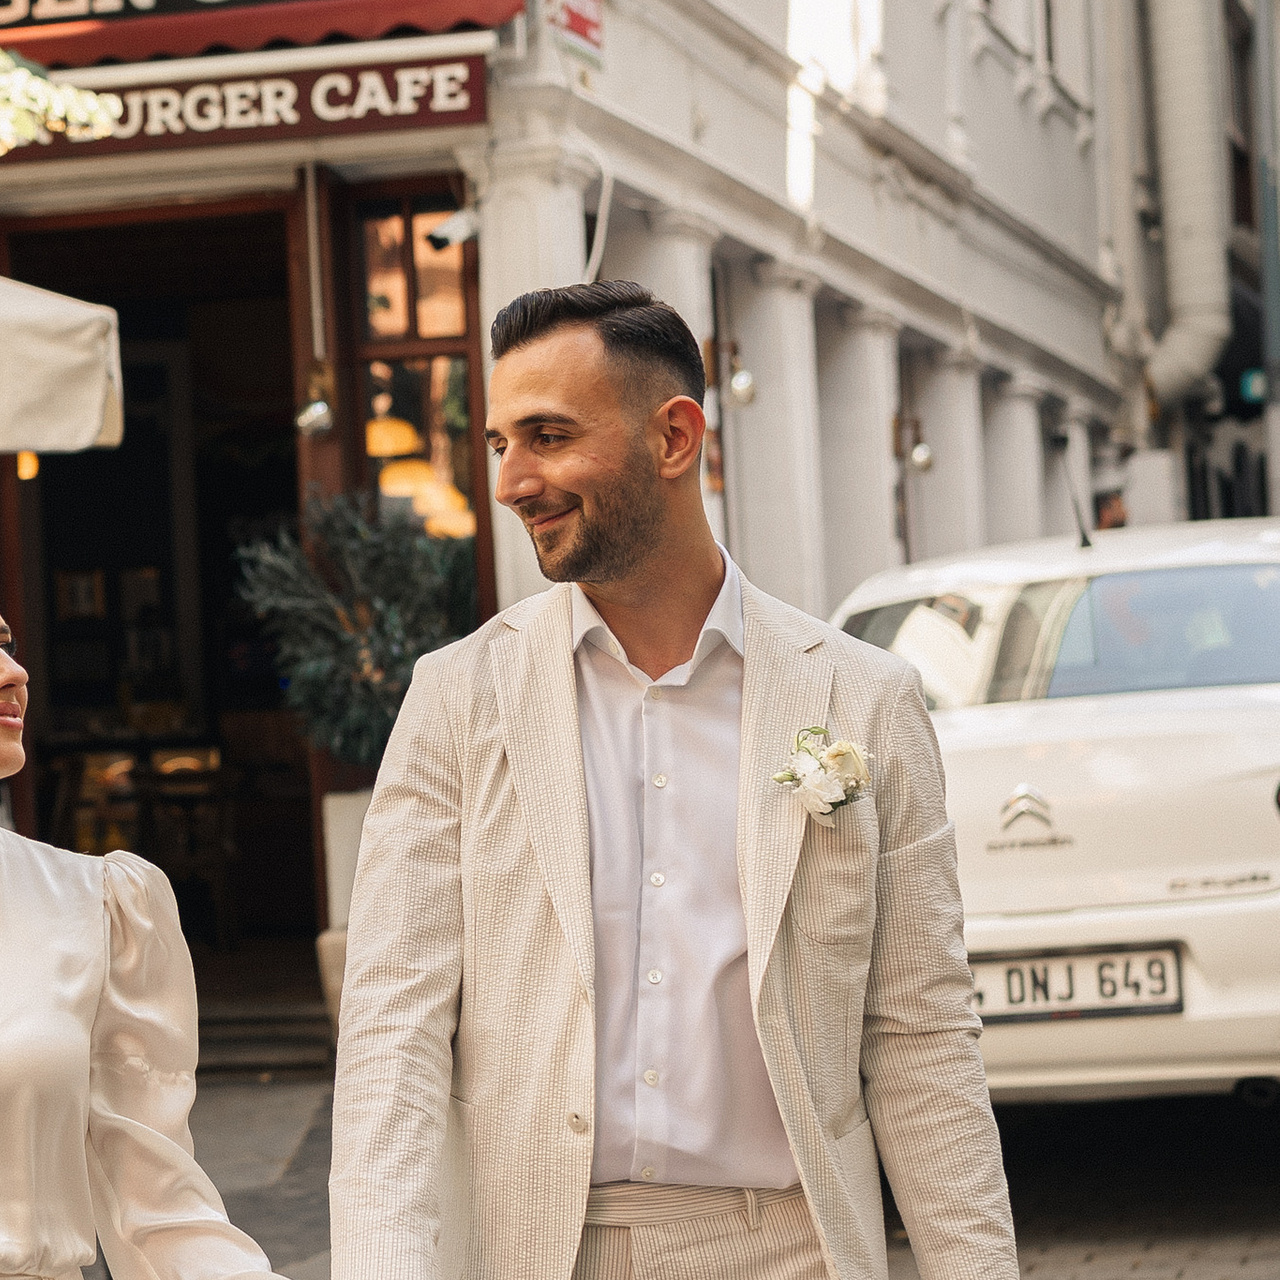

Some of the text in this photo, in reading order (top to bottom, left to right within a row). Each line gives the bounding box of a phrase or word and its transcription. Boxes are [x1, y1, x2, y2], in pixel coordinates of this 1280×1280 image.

[65, 78, 300, 142] URGER
[310, 63, 470, 121] CAFE
[1098, 959, 1166, 998] 649
